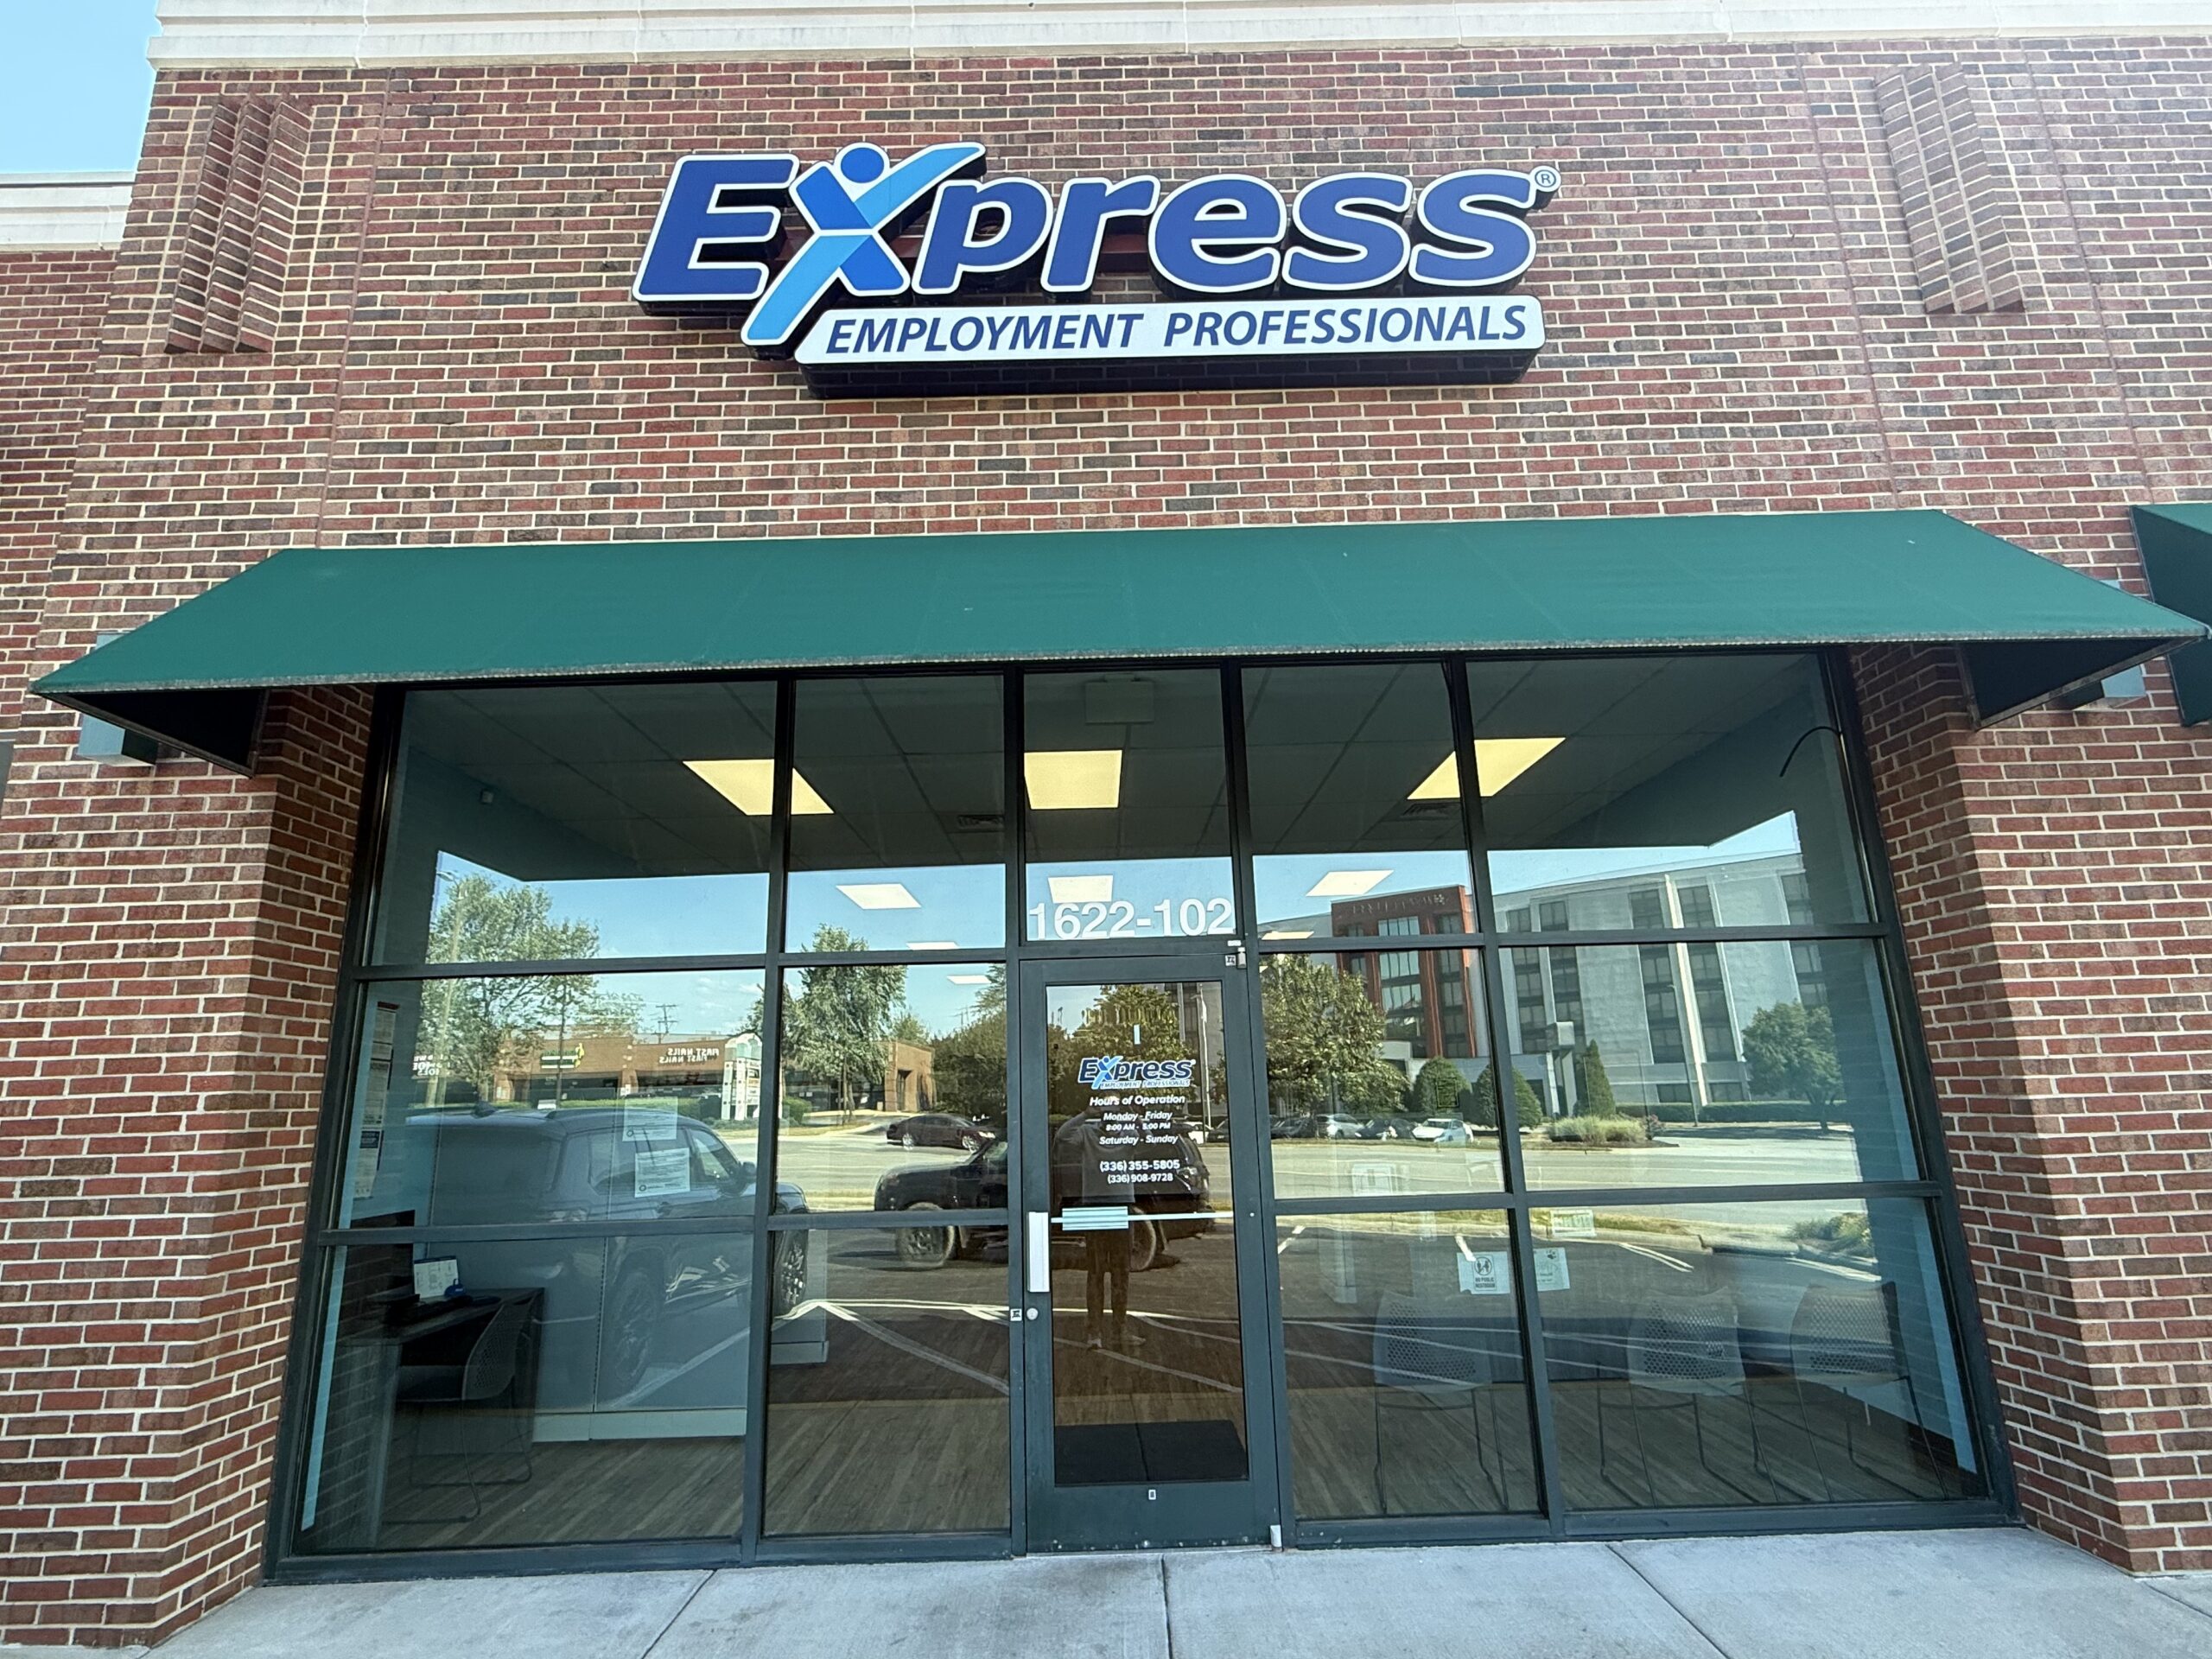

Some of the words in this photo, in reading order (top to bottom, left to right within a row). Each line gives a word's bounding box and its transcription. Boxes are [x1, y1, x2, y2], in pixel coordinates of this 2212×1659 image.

[825, 312, 1143, 355] EMPLOYMENT
[1163, 304, 1527, 348] PROFESSIONALS
[1029, 898, 1234, 940] 1622-102
[1090, 1096, 1120, 1106] Hours
[1122, 1096, 1134, 1105] of
[1135, 1094, 1186, 1106] Operation
[1103, 1112, 1139, 1122] Monday
[1145, 1110, 1173, 1121] Friday
[1099, 1135, 1139, 1146] Saturday
[1146, 1135, 1179, 1145] Sunday
[1099, 1160, 1127, 1173] (336)
[1128, 1160, 1180, 1171] 355-5805
[1107, 1174, 1130, 1184] (336)
[1131, 1173, 1173, 1183] 908-9728
